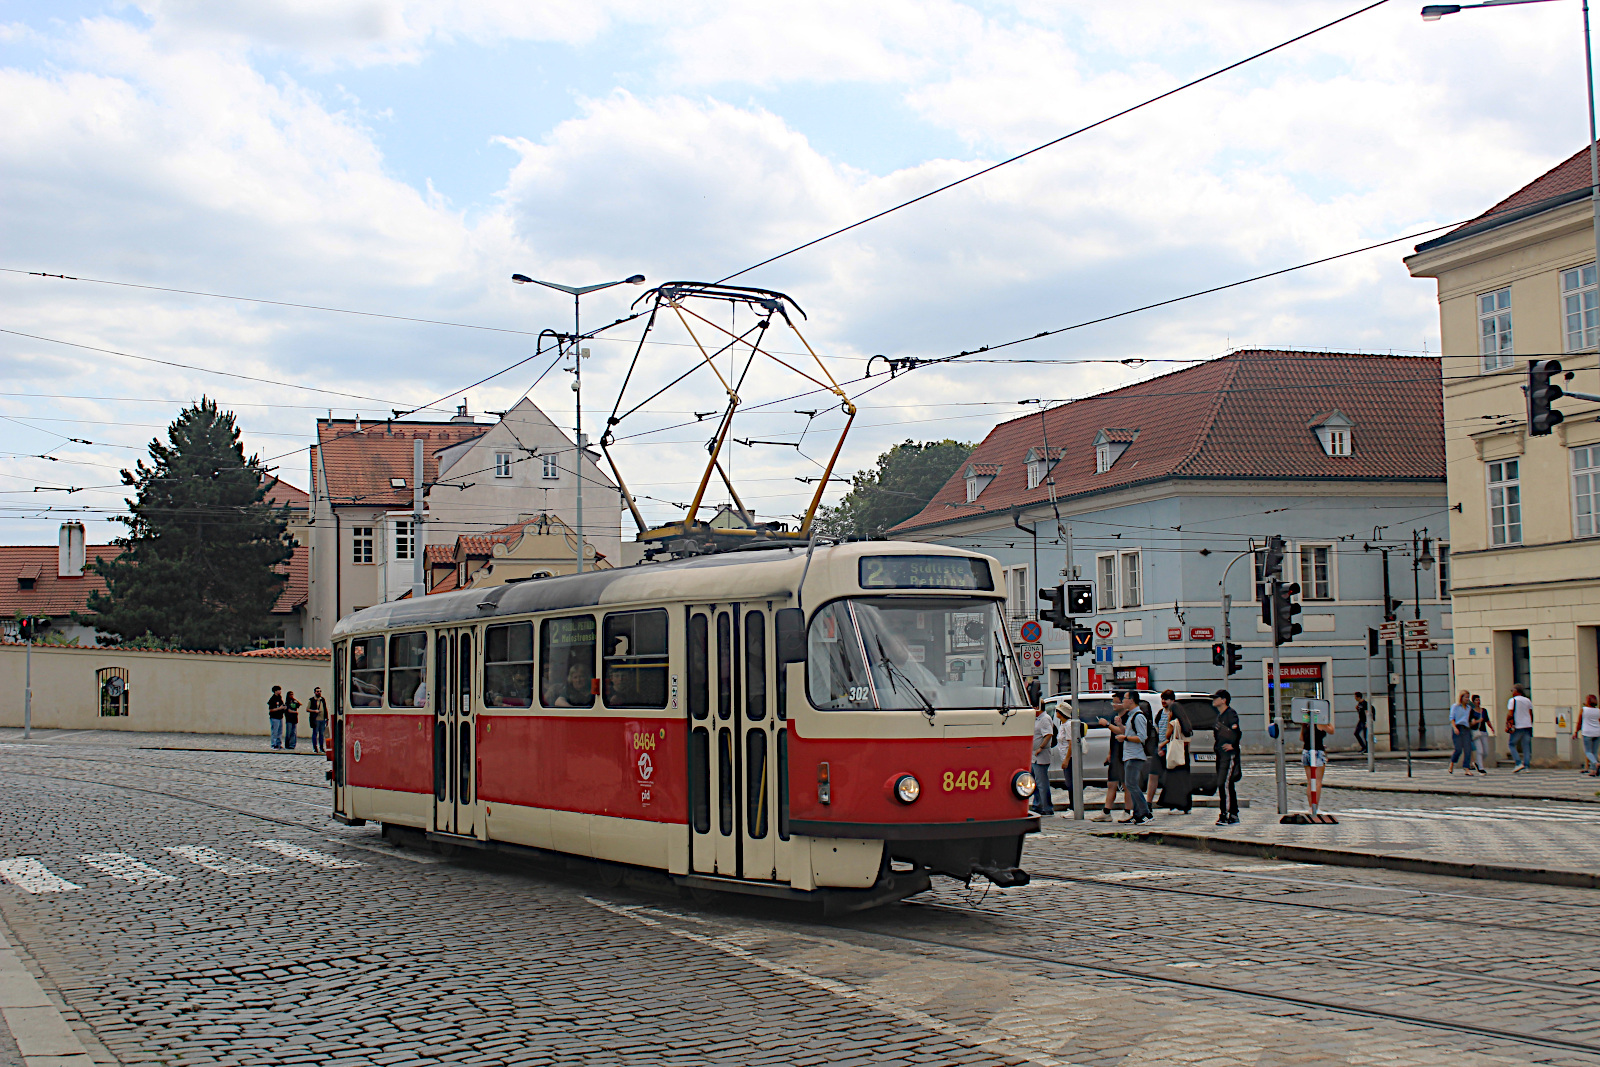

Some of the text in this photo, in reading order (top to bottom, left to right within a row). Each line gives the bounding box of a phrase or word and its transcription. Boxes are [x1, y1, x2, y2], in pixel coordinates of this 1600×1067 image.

[867, 561, 884, 585] 2
[552, 622, 559, 643] 2
[1116, 671, 1130, 679] SUPER
[1267, 667, 1318, 676] SUER MARKET
[849, 687, 869, 701] 302
[633, 732, 655, 750] 8464
[942, 769, 991, 792] 8464
[642, 790, 651, 801] pid
